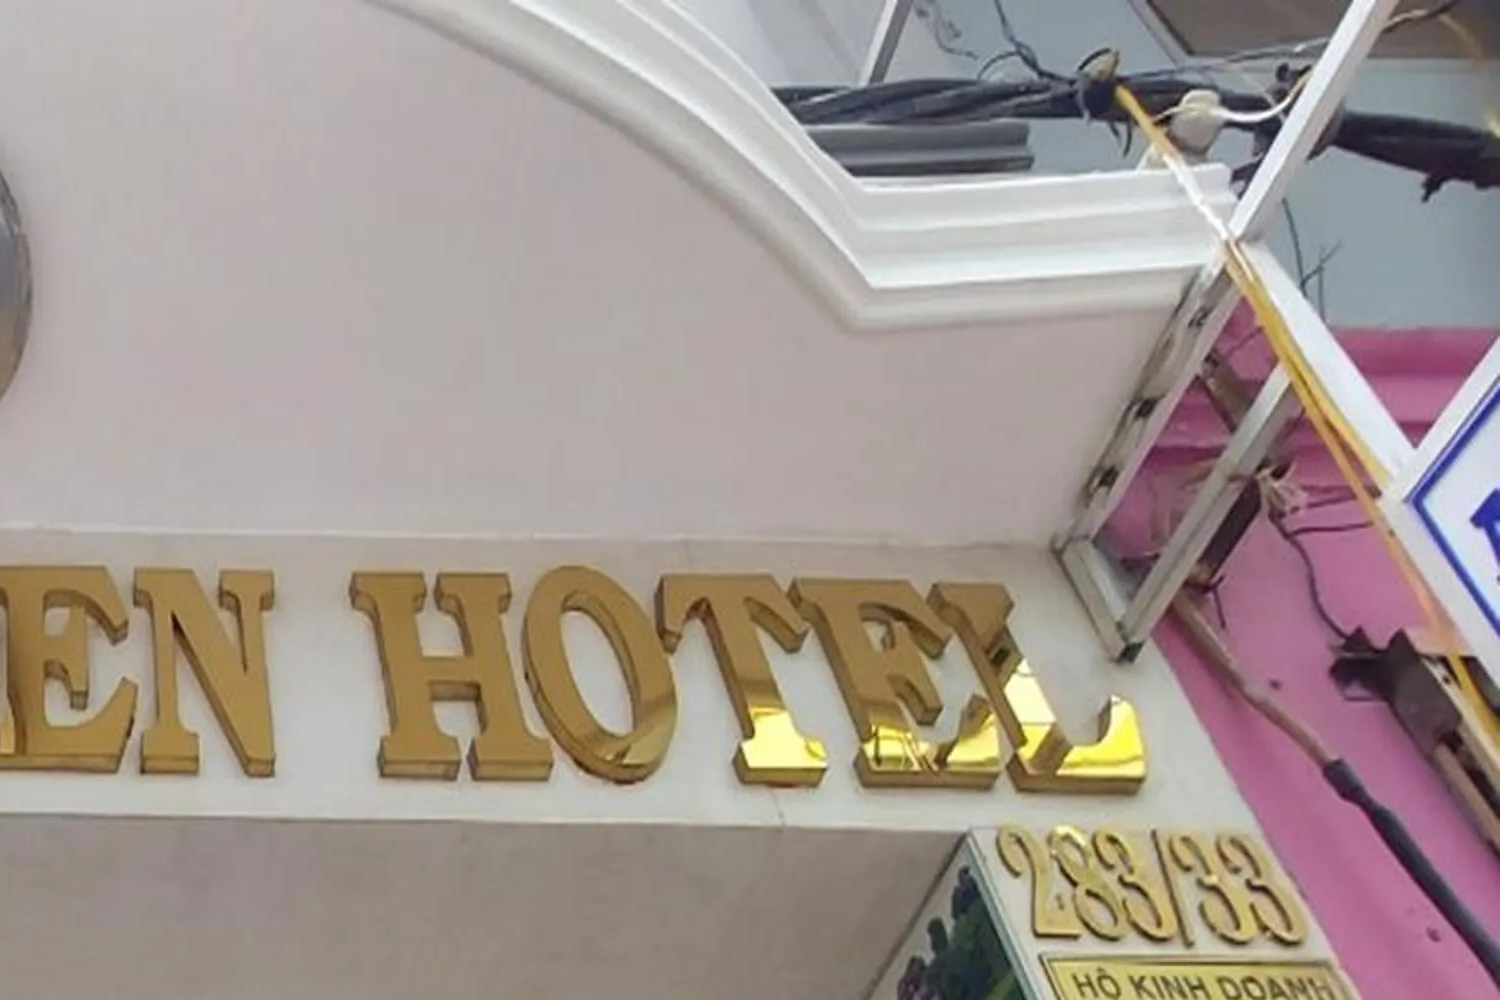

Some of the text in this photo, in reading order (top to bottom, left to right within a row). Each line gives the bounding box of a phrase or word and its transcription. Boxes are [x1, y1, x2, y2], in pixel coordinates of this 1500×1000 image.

[349, 565, 1146, 793] HOTEL
[996, 824, 1309, 949] 283/33
[1128, 974, 1212, 1000] KINH
